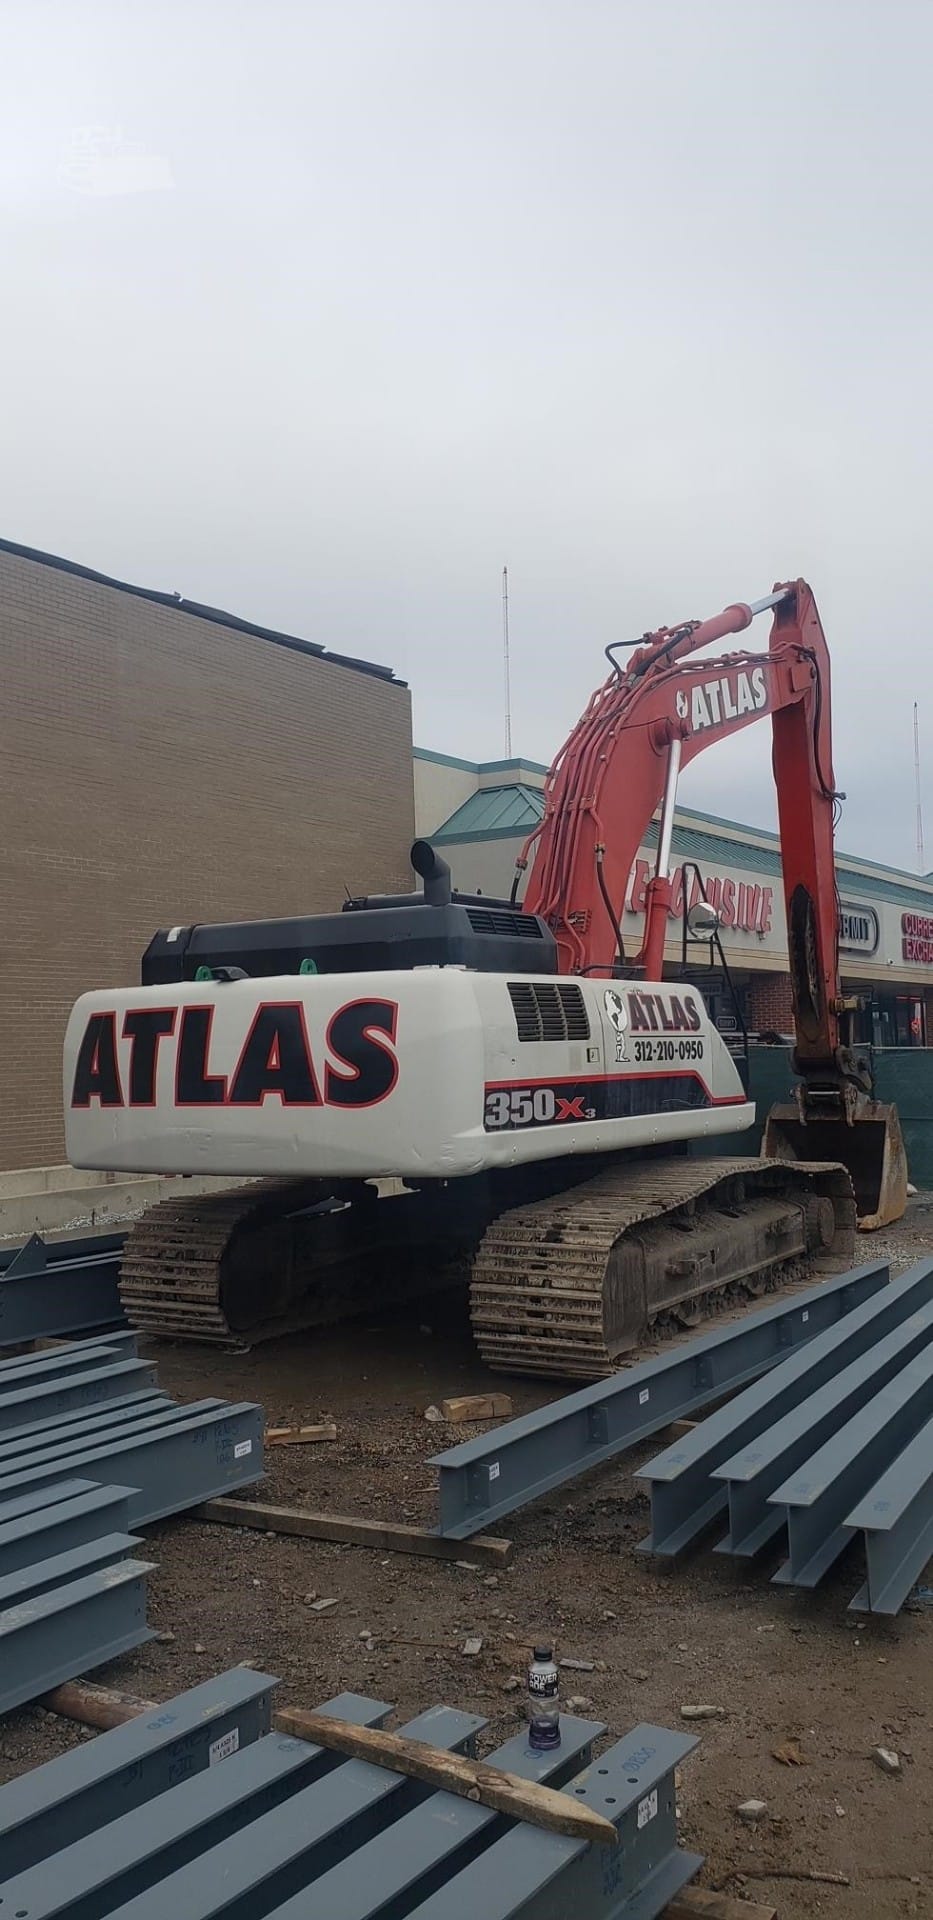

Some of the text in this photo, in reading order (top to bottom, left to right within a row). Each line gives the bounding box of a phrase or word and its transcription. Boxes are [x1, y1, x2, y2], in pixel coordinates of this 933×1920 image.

[691, 667, 767, 731] ATLAS
[626, 859, 773, 932] ECLUSIVE
[627, 993, 701, 1032] ATLAS
[71, 997, 399, 1108] ATLAS
[634, 1040, 704, 1061] 312-210-0950
[530, 1672, 557, 1683] POWER
